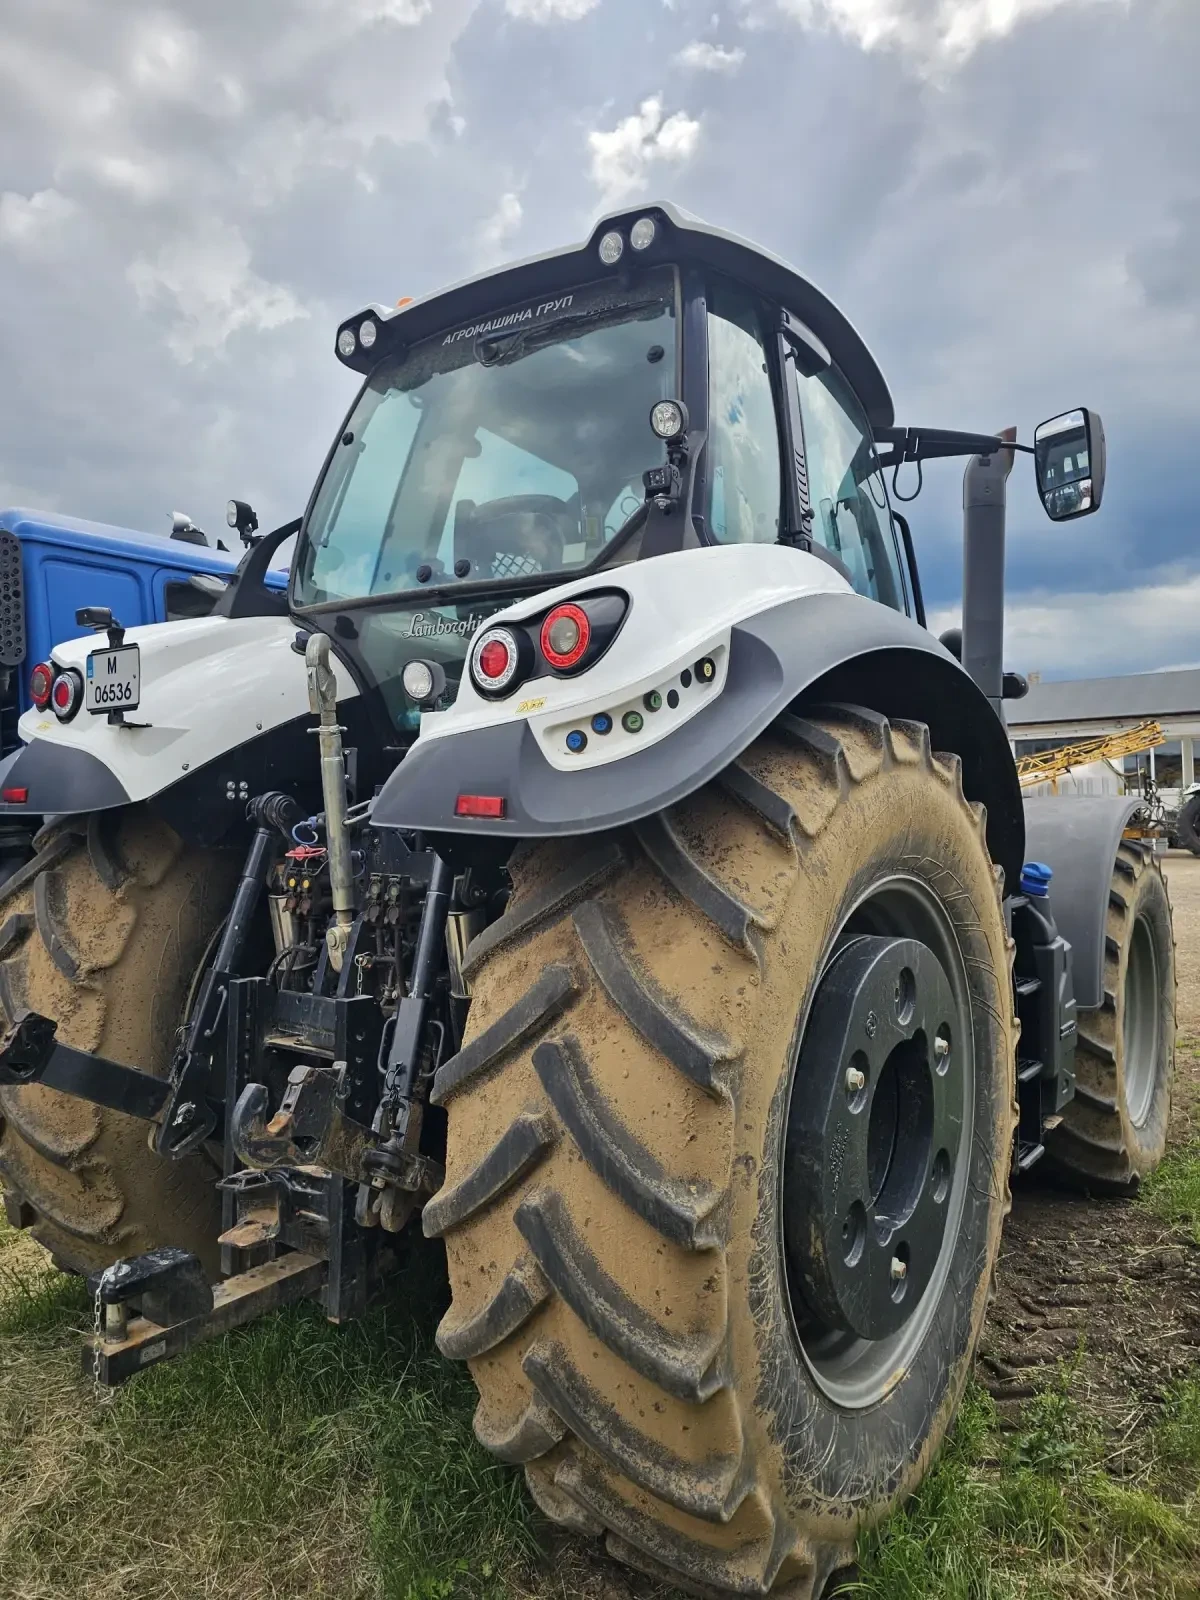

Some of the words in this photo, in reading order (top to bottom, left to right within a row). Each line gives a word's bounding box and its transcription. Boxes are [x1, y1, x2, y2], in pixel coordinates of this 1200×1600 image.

[442, 308, 532, 346] АГРОМАШИНА
[535, 295, 573, 317] ГРУП
[402, 613, 482, 639] Lamborghi
[107, 656, 117, 675] M
[95, 681, 132, 704] 06536
